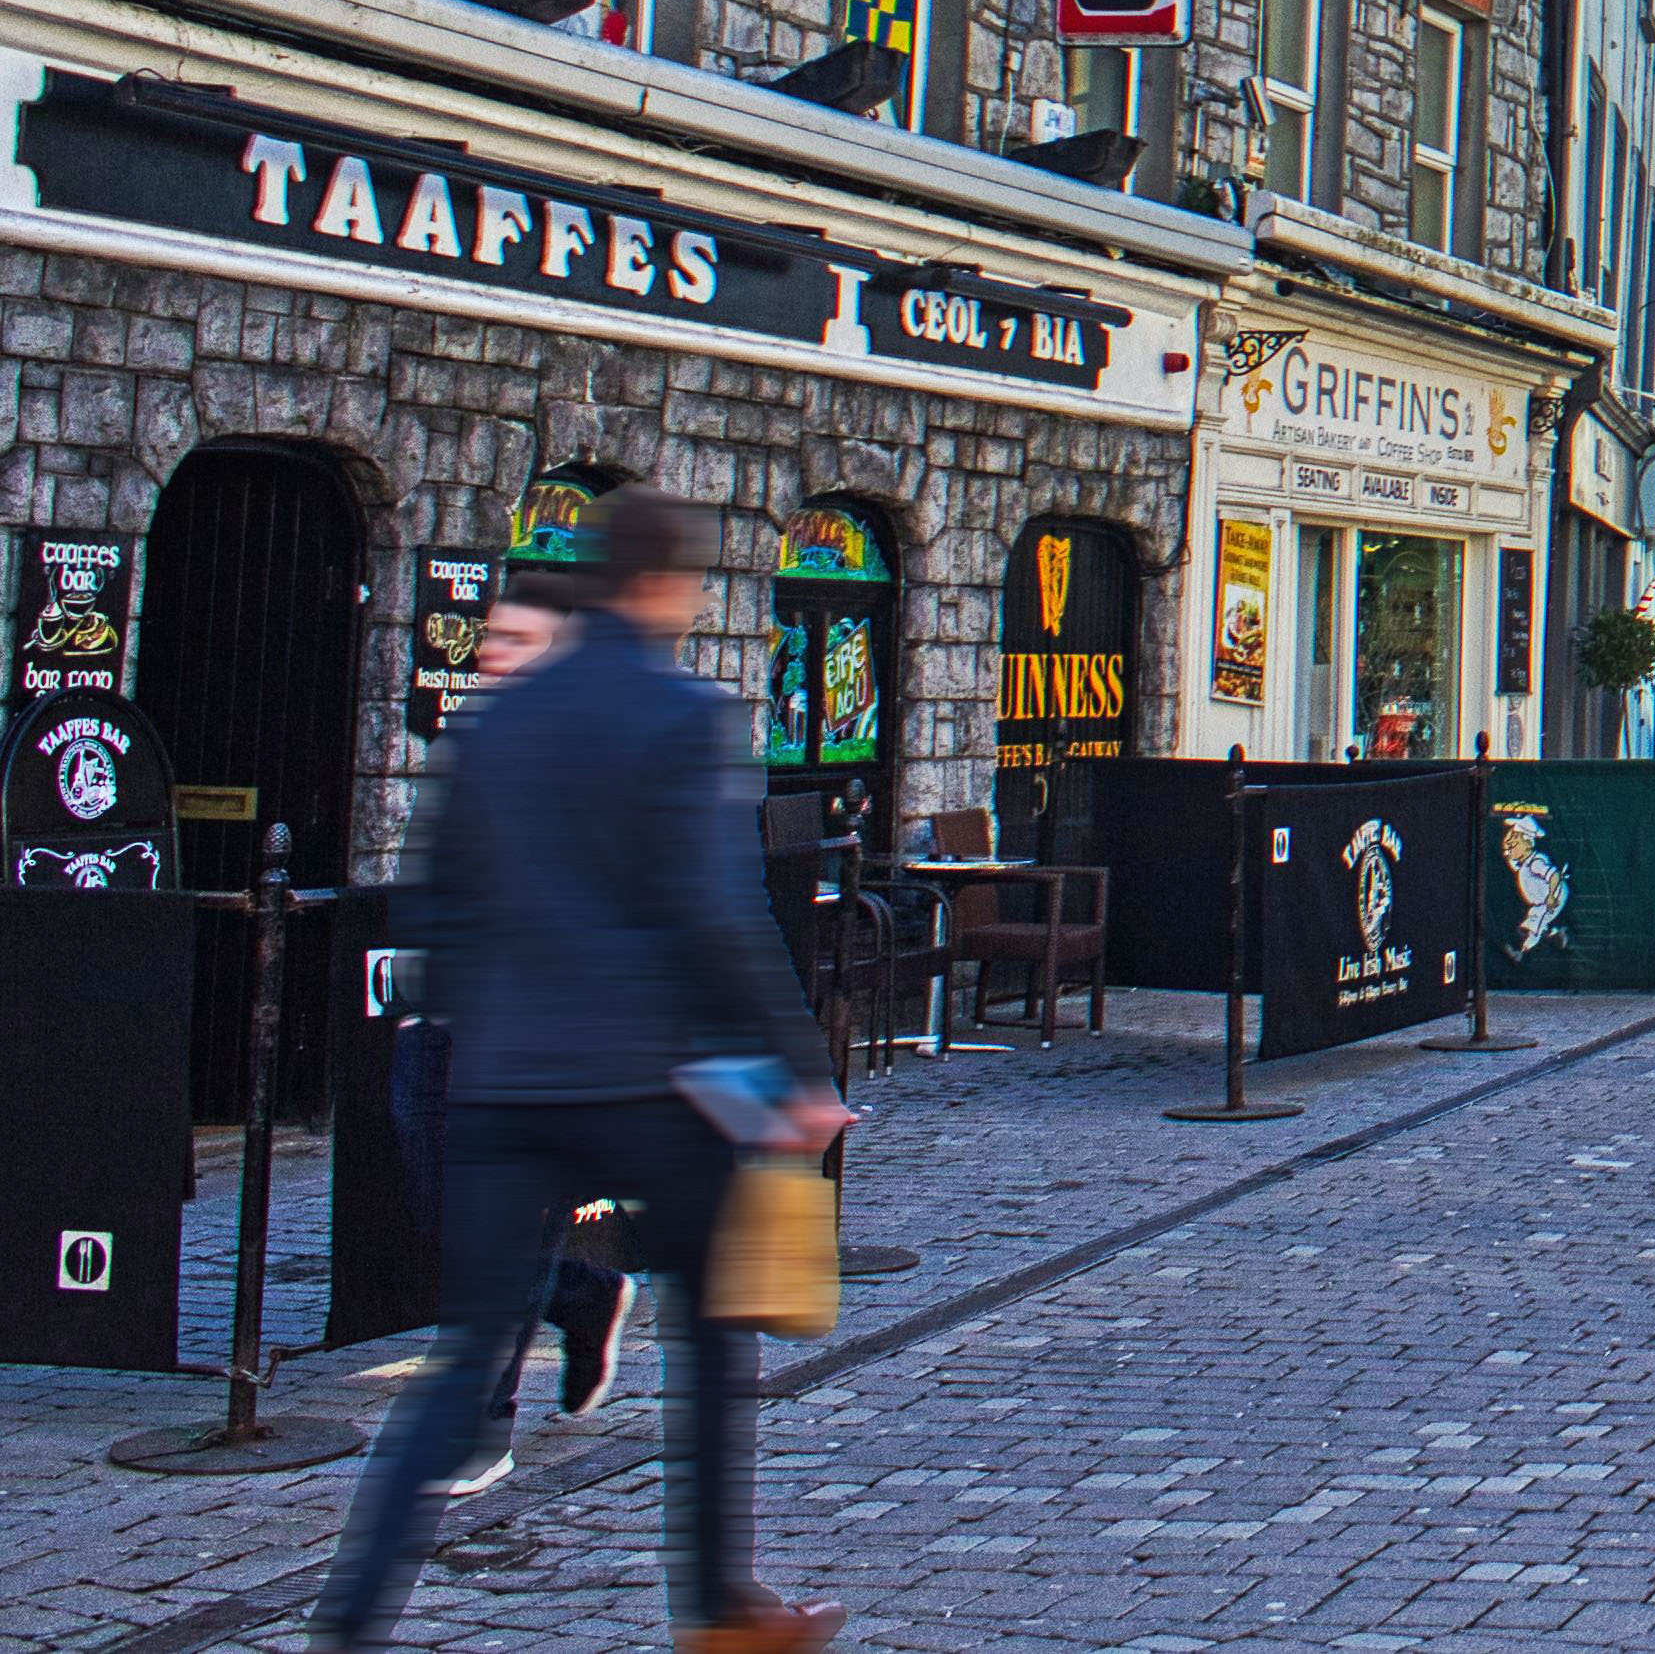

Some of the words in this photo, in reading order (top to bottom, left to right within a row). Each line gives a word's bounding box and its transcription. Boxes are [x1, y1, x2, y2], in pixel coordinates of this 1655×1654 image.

[241, 132, 720, 306] TAAFFES
[901, 289, 987, 351] CEOL
[1032, 312, 1086, 367] BIA
[1282, 346, 1459, 440] GRIFFIN'S
[1272, 419, 1315, 444] ARTISAN
[1317, 426, 1357, 450] BAKERY
[1377, 436, 1415, 461] COFFEE
[1417, 444, 1442, 465] SHOP
[1297, 466, 1341, 492] SEATING
[1363, 475, 1410, 501] AVAILABLE
[1430, 485, 1459, 507] INSIDE
[101, 721, 131, 755] BAR
[1338, 956, 1360, 981] Live
